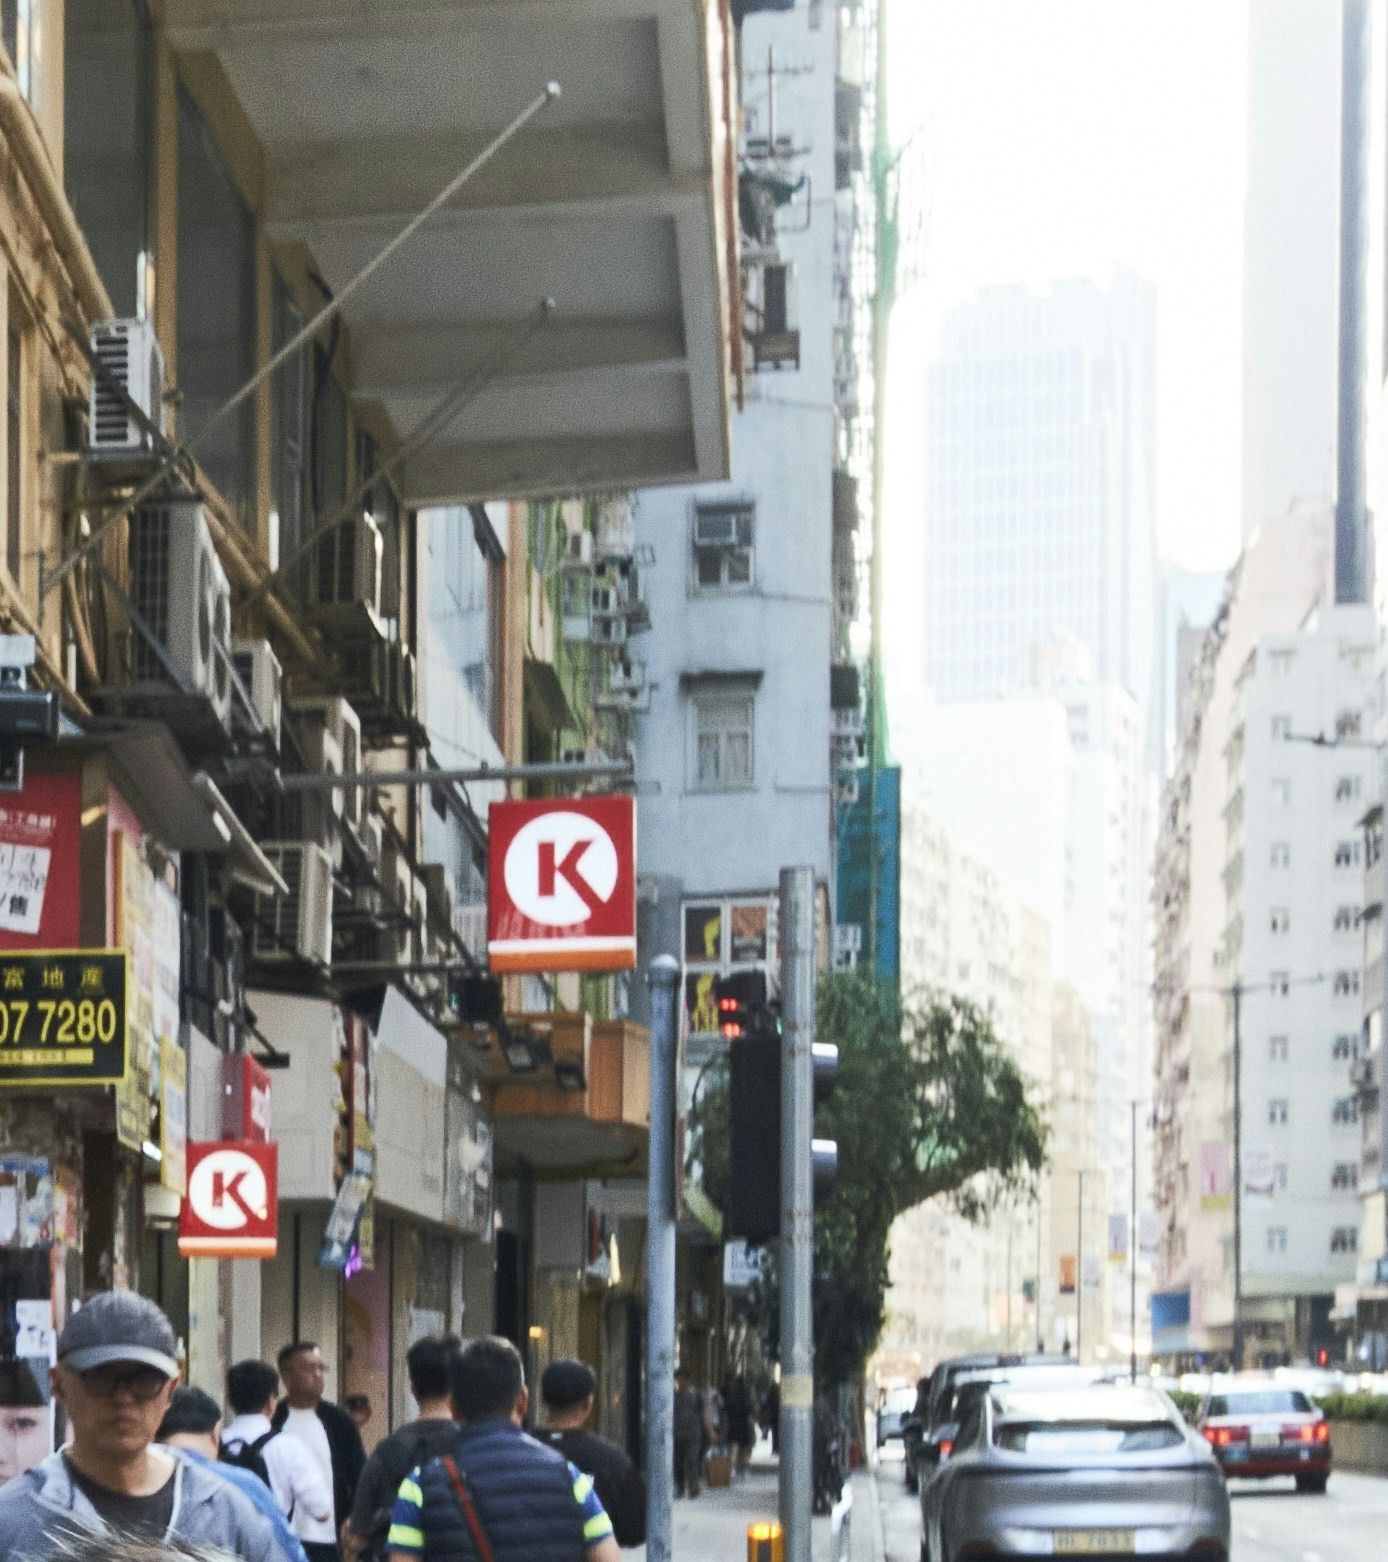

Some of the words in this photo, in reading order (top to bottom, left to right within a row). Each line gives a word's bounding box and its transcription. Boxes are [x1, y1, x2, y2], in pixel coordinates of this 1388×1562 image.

[537, 839, 608, 904] K
[37, 998, 117, 1044] 7280
[212, 1170, 260, 1214] K
